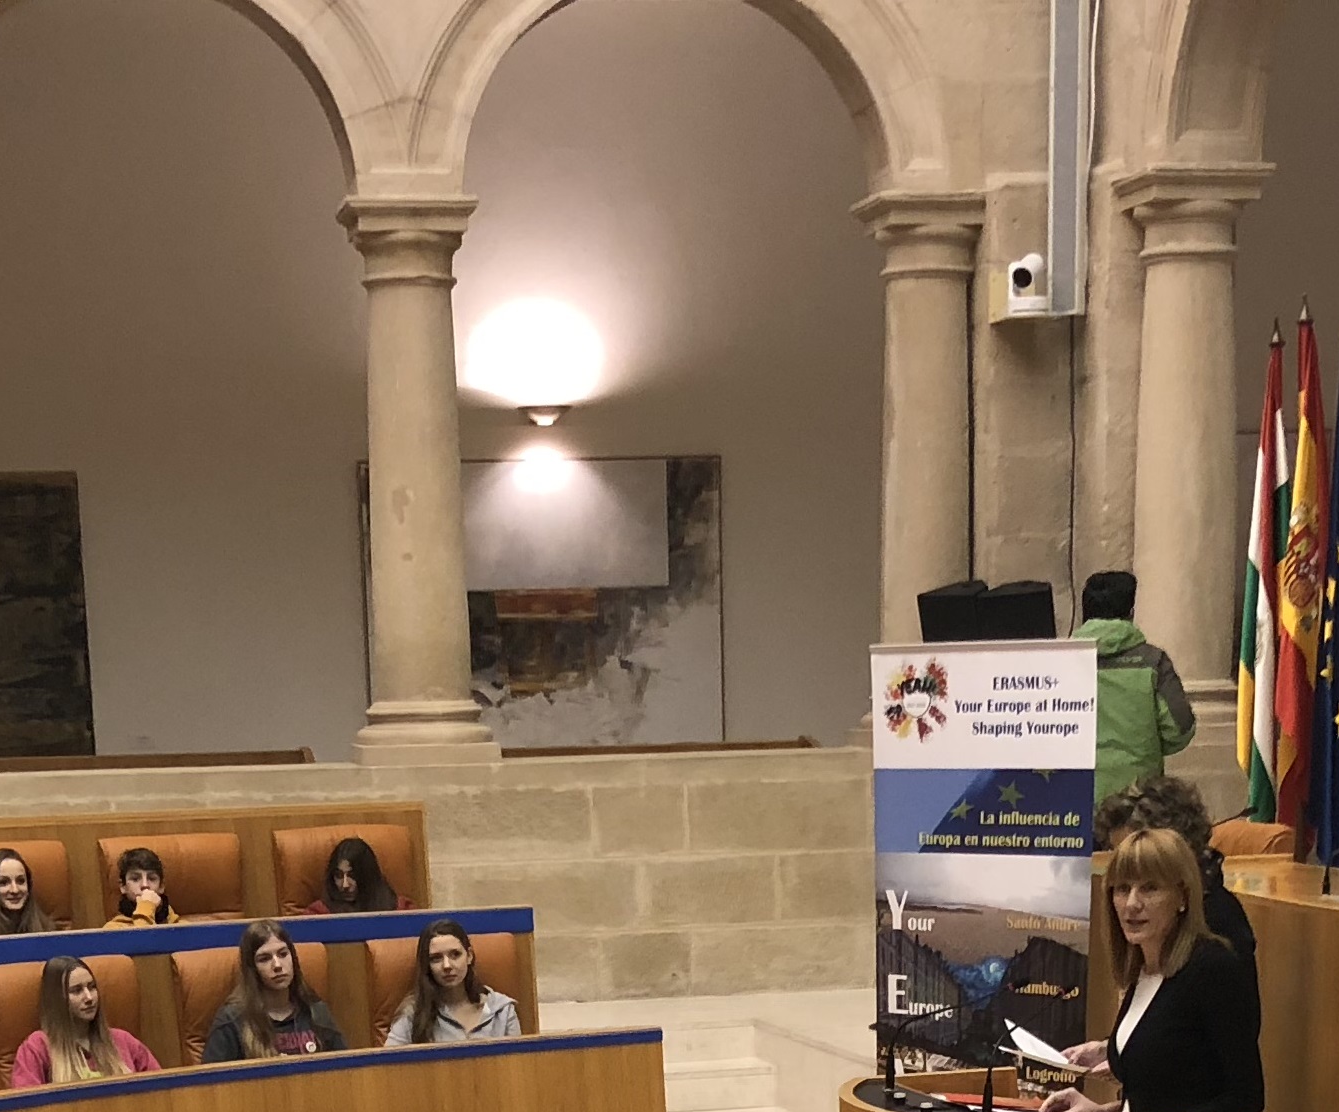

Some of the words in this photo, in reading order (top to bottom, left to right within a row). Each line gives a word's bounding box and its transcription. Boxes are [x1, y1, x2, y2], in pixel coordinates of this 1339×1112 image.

[993, 676, 1059, 690] ERASMUS+
[955, 700, 982, 713] Your
[987, 700, 1031, 715] Europe
[1035, 699, 1048, 712] at
[1052, 697, 1094, 712] Home!
[972, 722, 1023, 737] Shaping
[1027, 722, 1079, 737] Yourope
[980, 811, 995, 825] La
[999, 811, 1060, 825] influencia
[1064, 812, 1080, 826] de
[918, 832, 960, 847] Europa
[965, 835, 978, 847] en
[982, 834, 1030, 847] nuestro
[1034, 834, 1084, 848] entorno
[885, 890, 936, 931] Your
[887, 974, 954, 1021] Europe
